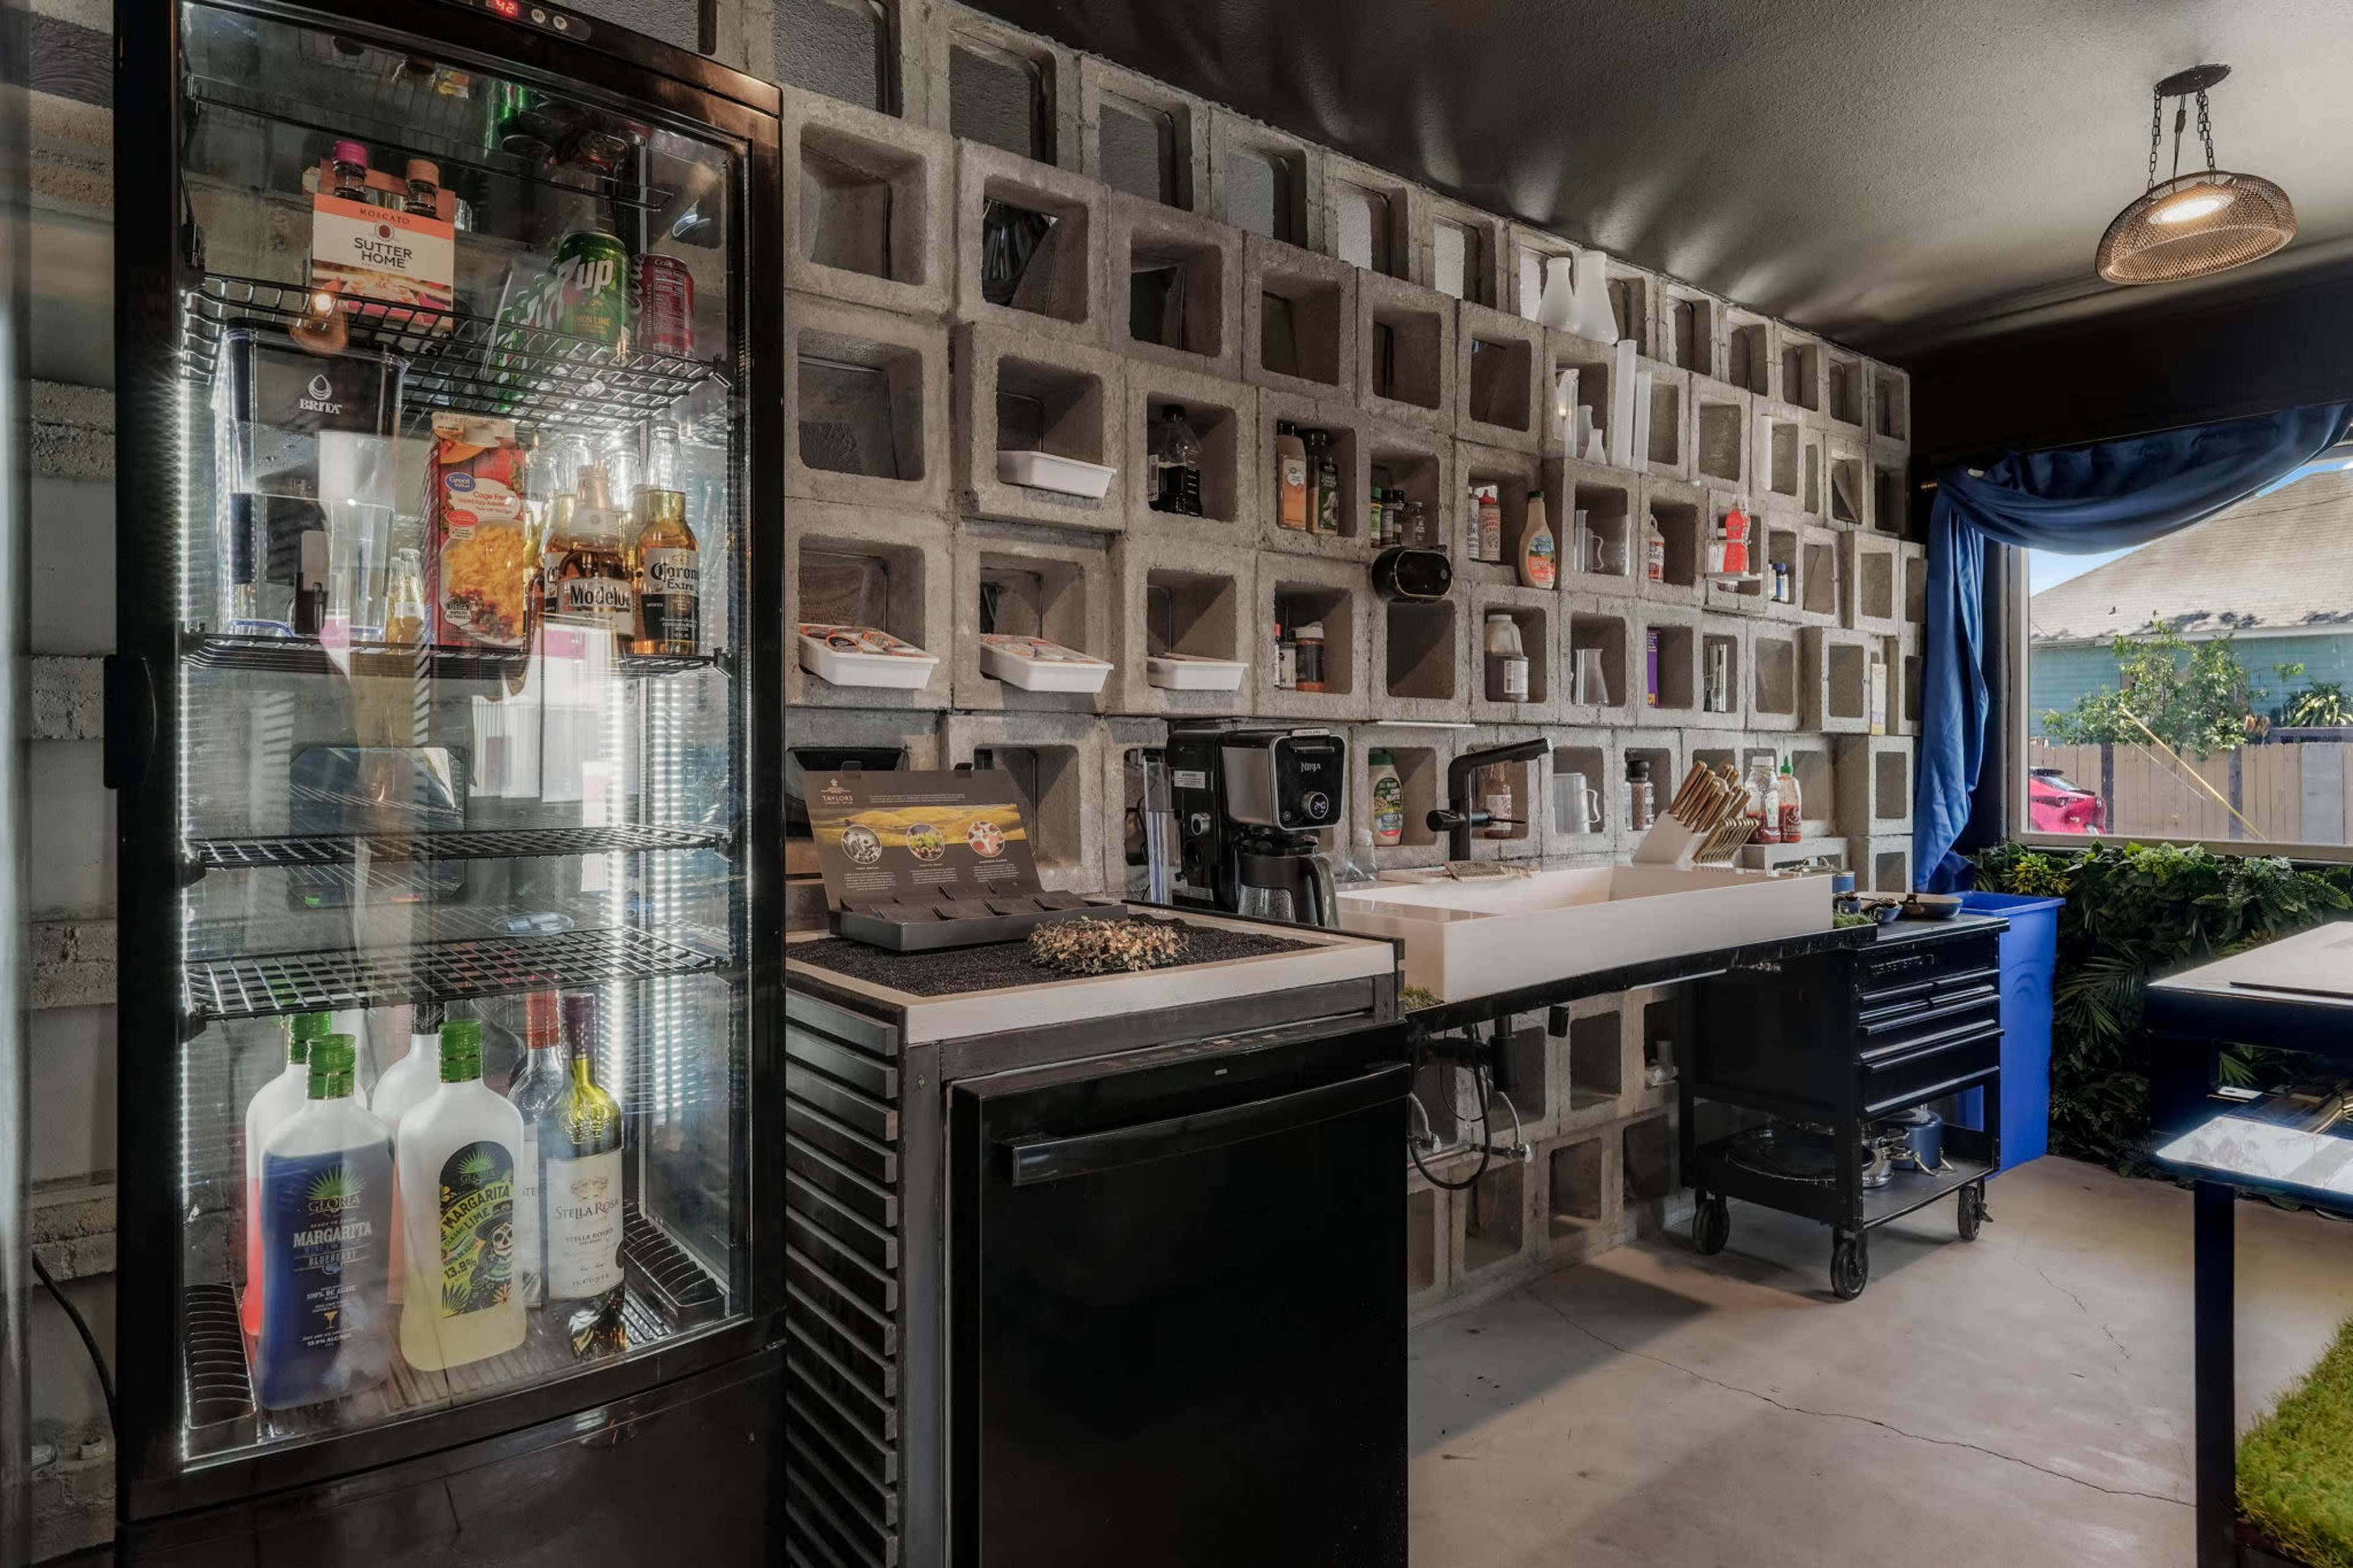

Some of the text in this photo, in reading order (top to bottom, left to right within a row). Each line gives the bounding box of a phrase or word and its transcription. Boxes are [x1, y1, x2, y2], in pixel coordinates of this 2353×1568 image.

[358, 208, 410, 224] MOSCATO
[354, 237, 412, 259] SUTTER
[361, 251, 406, 268] HOME
[299, 399, 343, 414] BRITA
[472, 491, 494, 499] Cage
[1300, 762, 1321, 773] NINJA
[308, 1195, 360, 1212] GLORIA
[442, 1185, 510, 1229] MARGARITA
[555, 1198, 620, 1220] STELLA ROSA
[464, 1207, 491, 1230] LIME
[294, 1221, 373, 1248] MARGARITA
[566, 1234, 591, 1243] STELLA
[309, 1249, 357, 1266] BLUEBERRY
[444, 1257, 477, 1279] 13.9%
